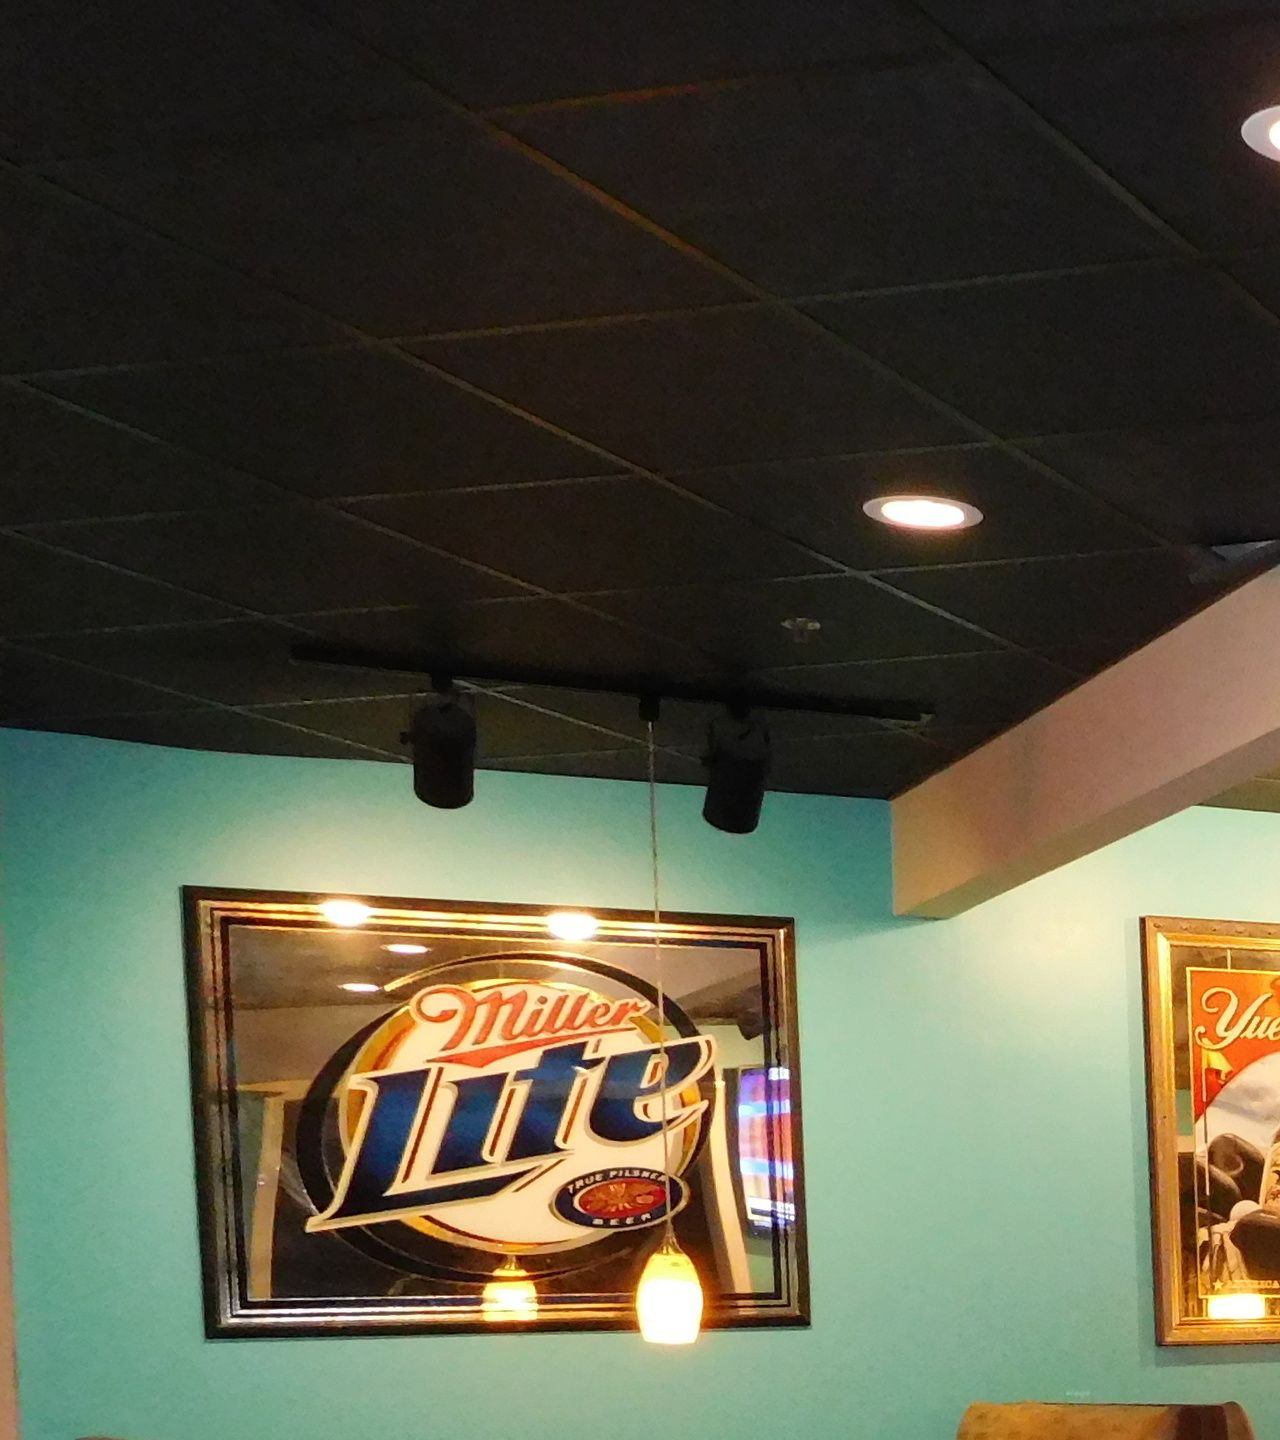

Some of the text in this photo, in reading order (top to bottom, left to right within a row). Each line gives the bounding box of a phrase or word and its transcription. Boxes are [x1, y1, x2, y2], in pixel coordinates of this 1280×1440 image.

[415, 987, 646, 1052] Miller
[310, 1036, 715, 1230] Lite
[567, 1173, 603, 1194] TRUE
[592, 1212, 652, 1226] BEER
